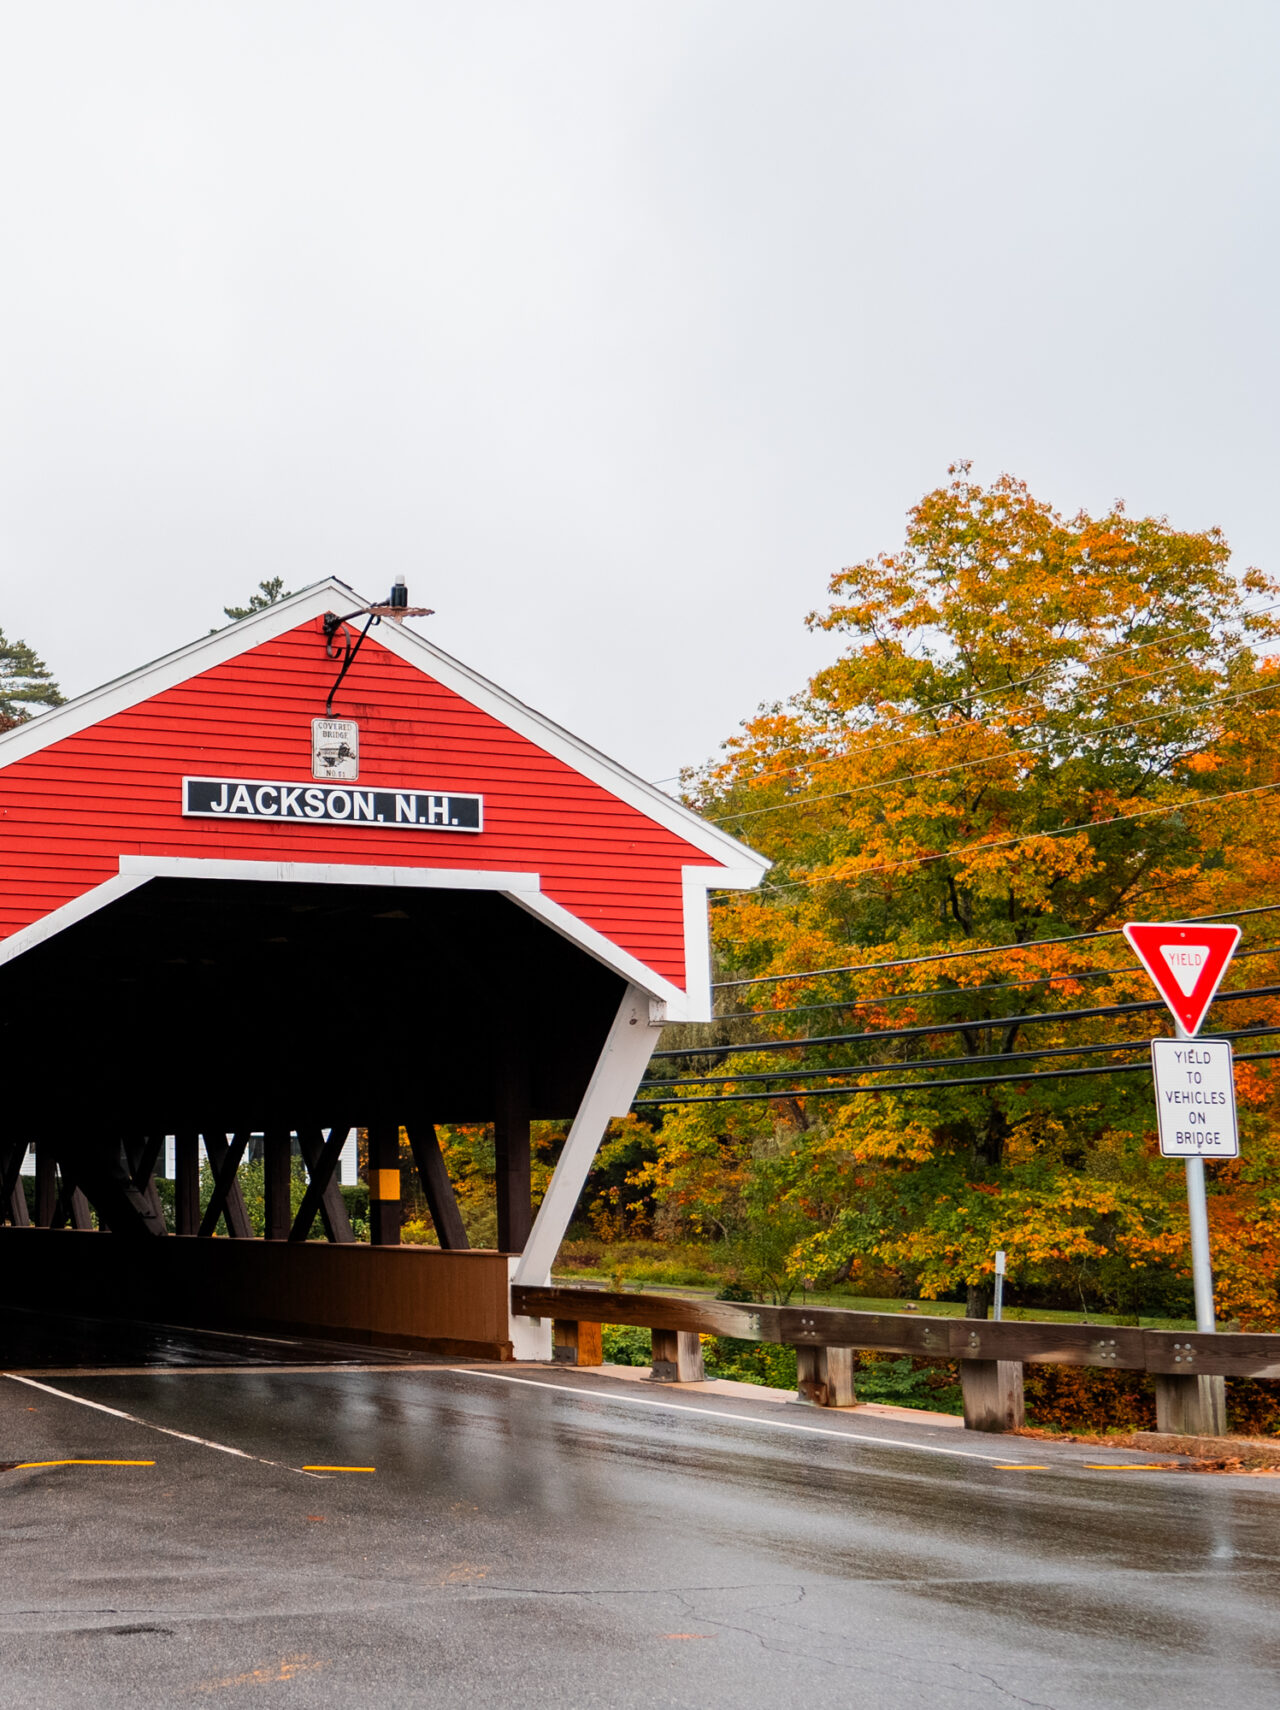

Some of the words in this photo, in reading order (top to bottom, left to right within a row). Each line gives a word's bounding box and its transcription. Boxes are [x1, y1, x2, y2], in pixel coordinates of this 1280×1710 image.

[318, 722, 352, 731] COVERED
[322, 730, 348, 739] BRIDGE
[210, 784, 384, 823] JACKSON,
[395, 794, 459, 826] N.H.
[1169, 953, 1202, 966] YIELD
[1174, 1051, 1211, 1065] YIELD
[1186, 1071, 1202, 1085] TO
[1165, 1091, 1226, 1105] VEHICLES
[1189, 1111, 1205, 1125] ON
[1176, 1131, 1221, 1145] BRIDGE
